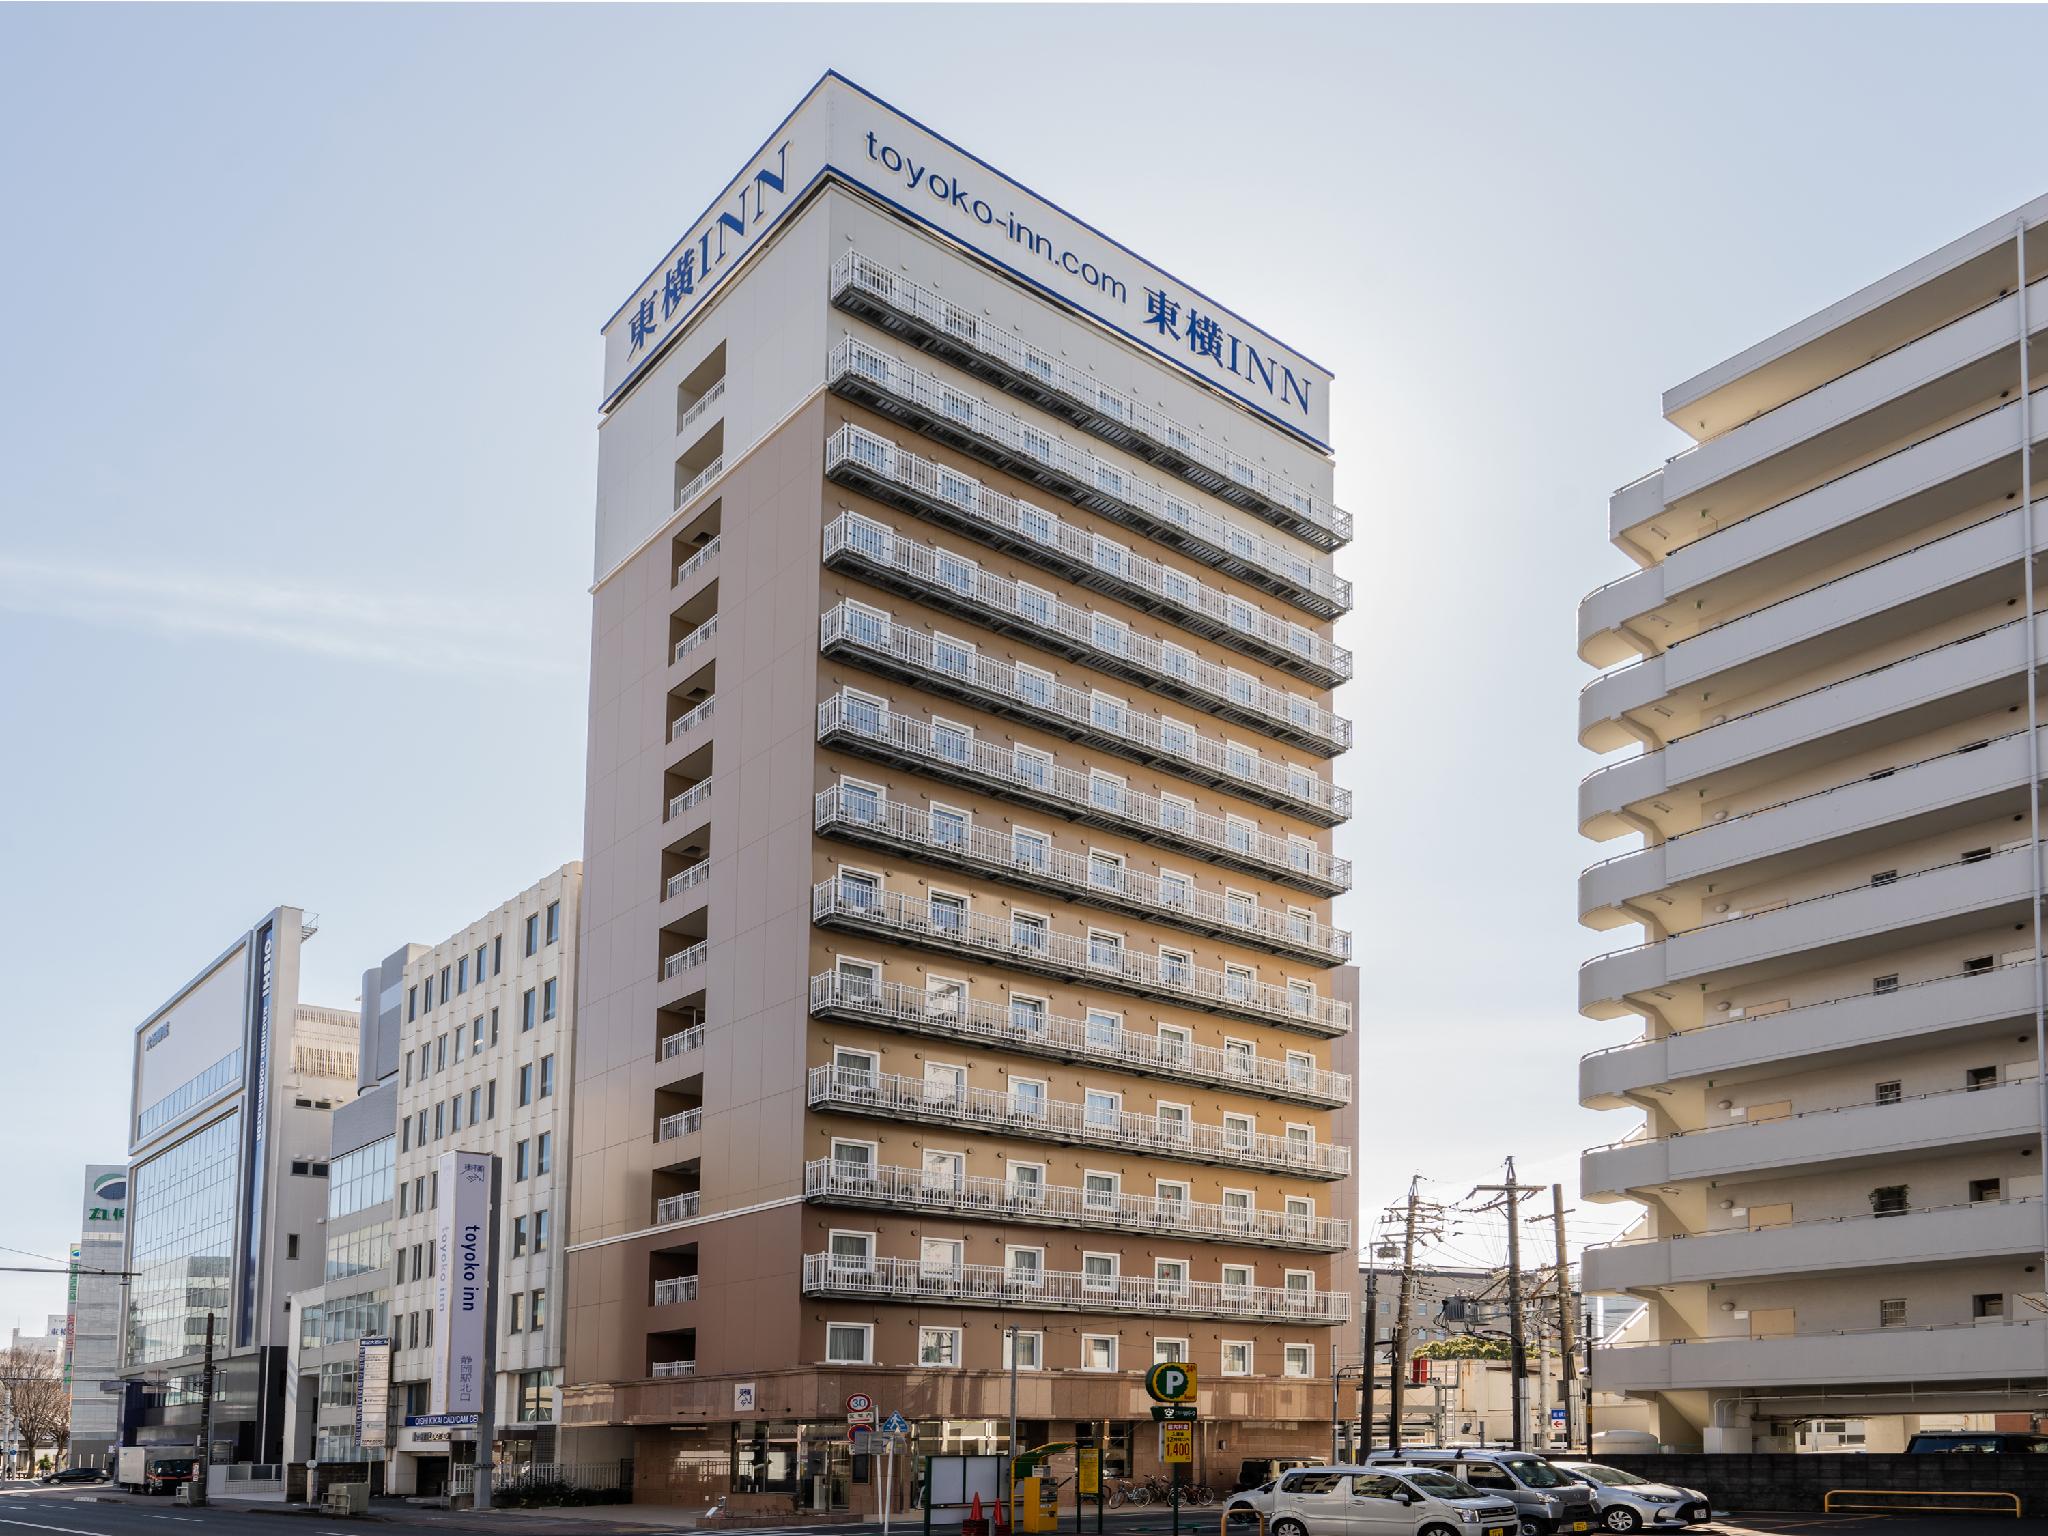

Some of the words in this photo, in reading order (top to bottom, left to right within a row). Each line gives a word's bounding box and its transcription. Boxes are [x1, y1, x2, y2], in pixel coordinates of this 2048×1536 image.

[866, 130, 1127, 305] toyoko-inn.com
[627, 140, 791, 361] 東横INN
[1142, 285, 1312, 415] 東横INN
[263, 939, 272, 997] OISHI
[256, 1061, 266, 1142] COORDINATOR
[461, 1224, 480, 1281] toyoko
[462, 1287, 480, 1311] inn
[852, 1398, 867, 1408] 30
[1166, 1370, 1185, 1395] P
[1166, 1443, 1190, 1457] 1,400
